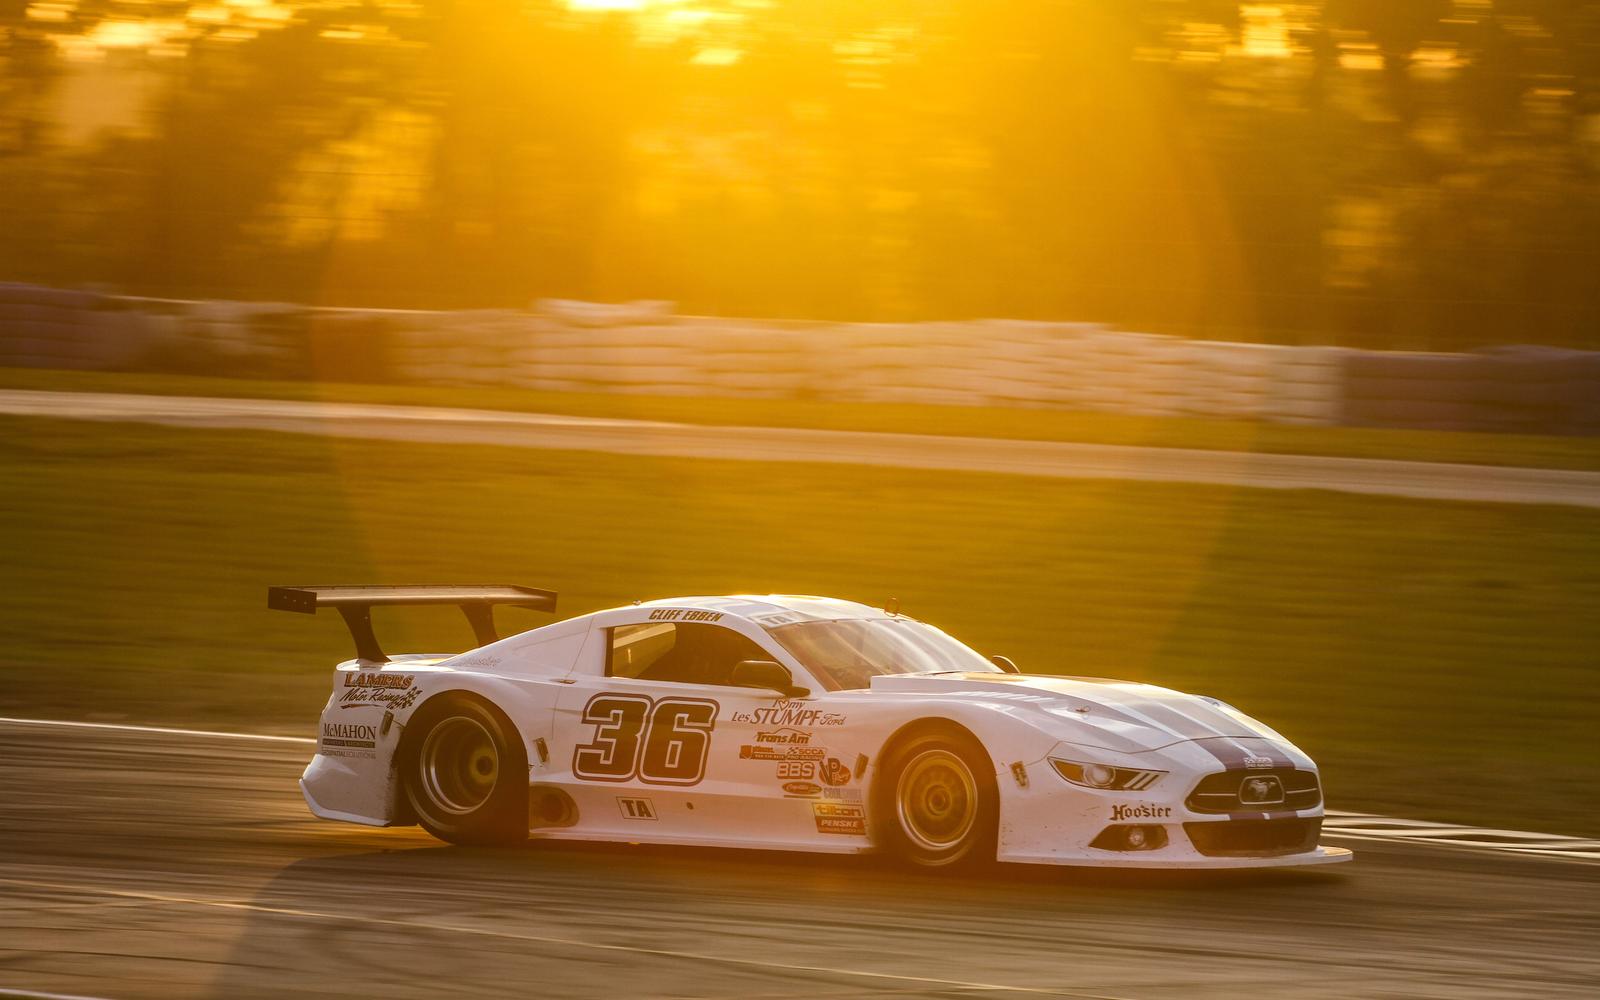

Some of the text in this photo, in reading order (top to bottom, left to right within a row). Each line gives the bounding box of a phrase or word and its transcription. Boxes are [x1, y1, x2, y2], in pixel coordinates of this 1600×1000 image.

[648, 609, 724, 622] CLIFF EBBEN
[344, 672, 415, 690] LAMERS
[339, 688, 404, 706] Motor Racing
[788, 700, 805, 711] my
[731, 708, 847, 726] Les STUMPF Ford
[323, 723, 377, 740] McMAHON
[572, 692, 720, 787] 36
[756, 732, 810, 745] Trans Am
[778, 761, 815, 779] BBS
[622, 800, 652, 817] TA
[1109, 803, 1171, 820] Hoosier
[821, 820, 858, 828] PENSKE
